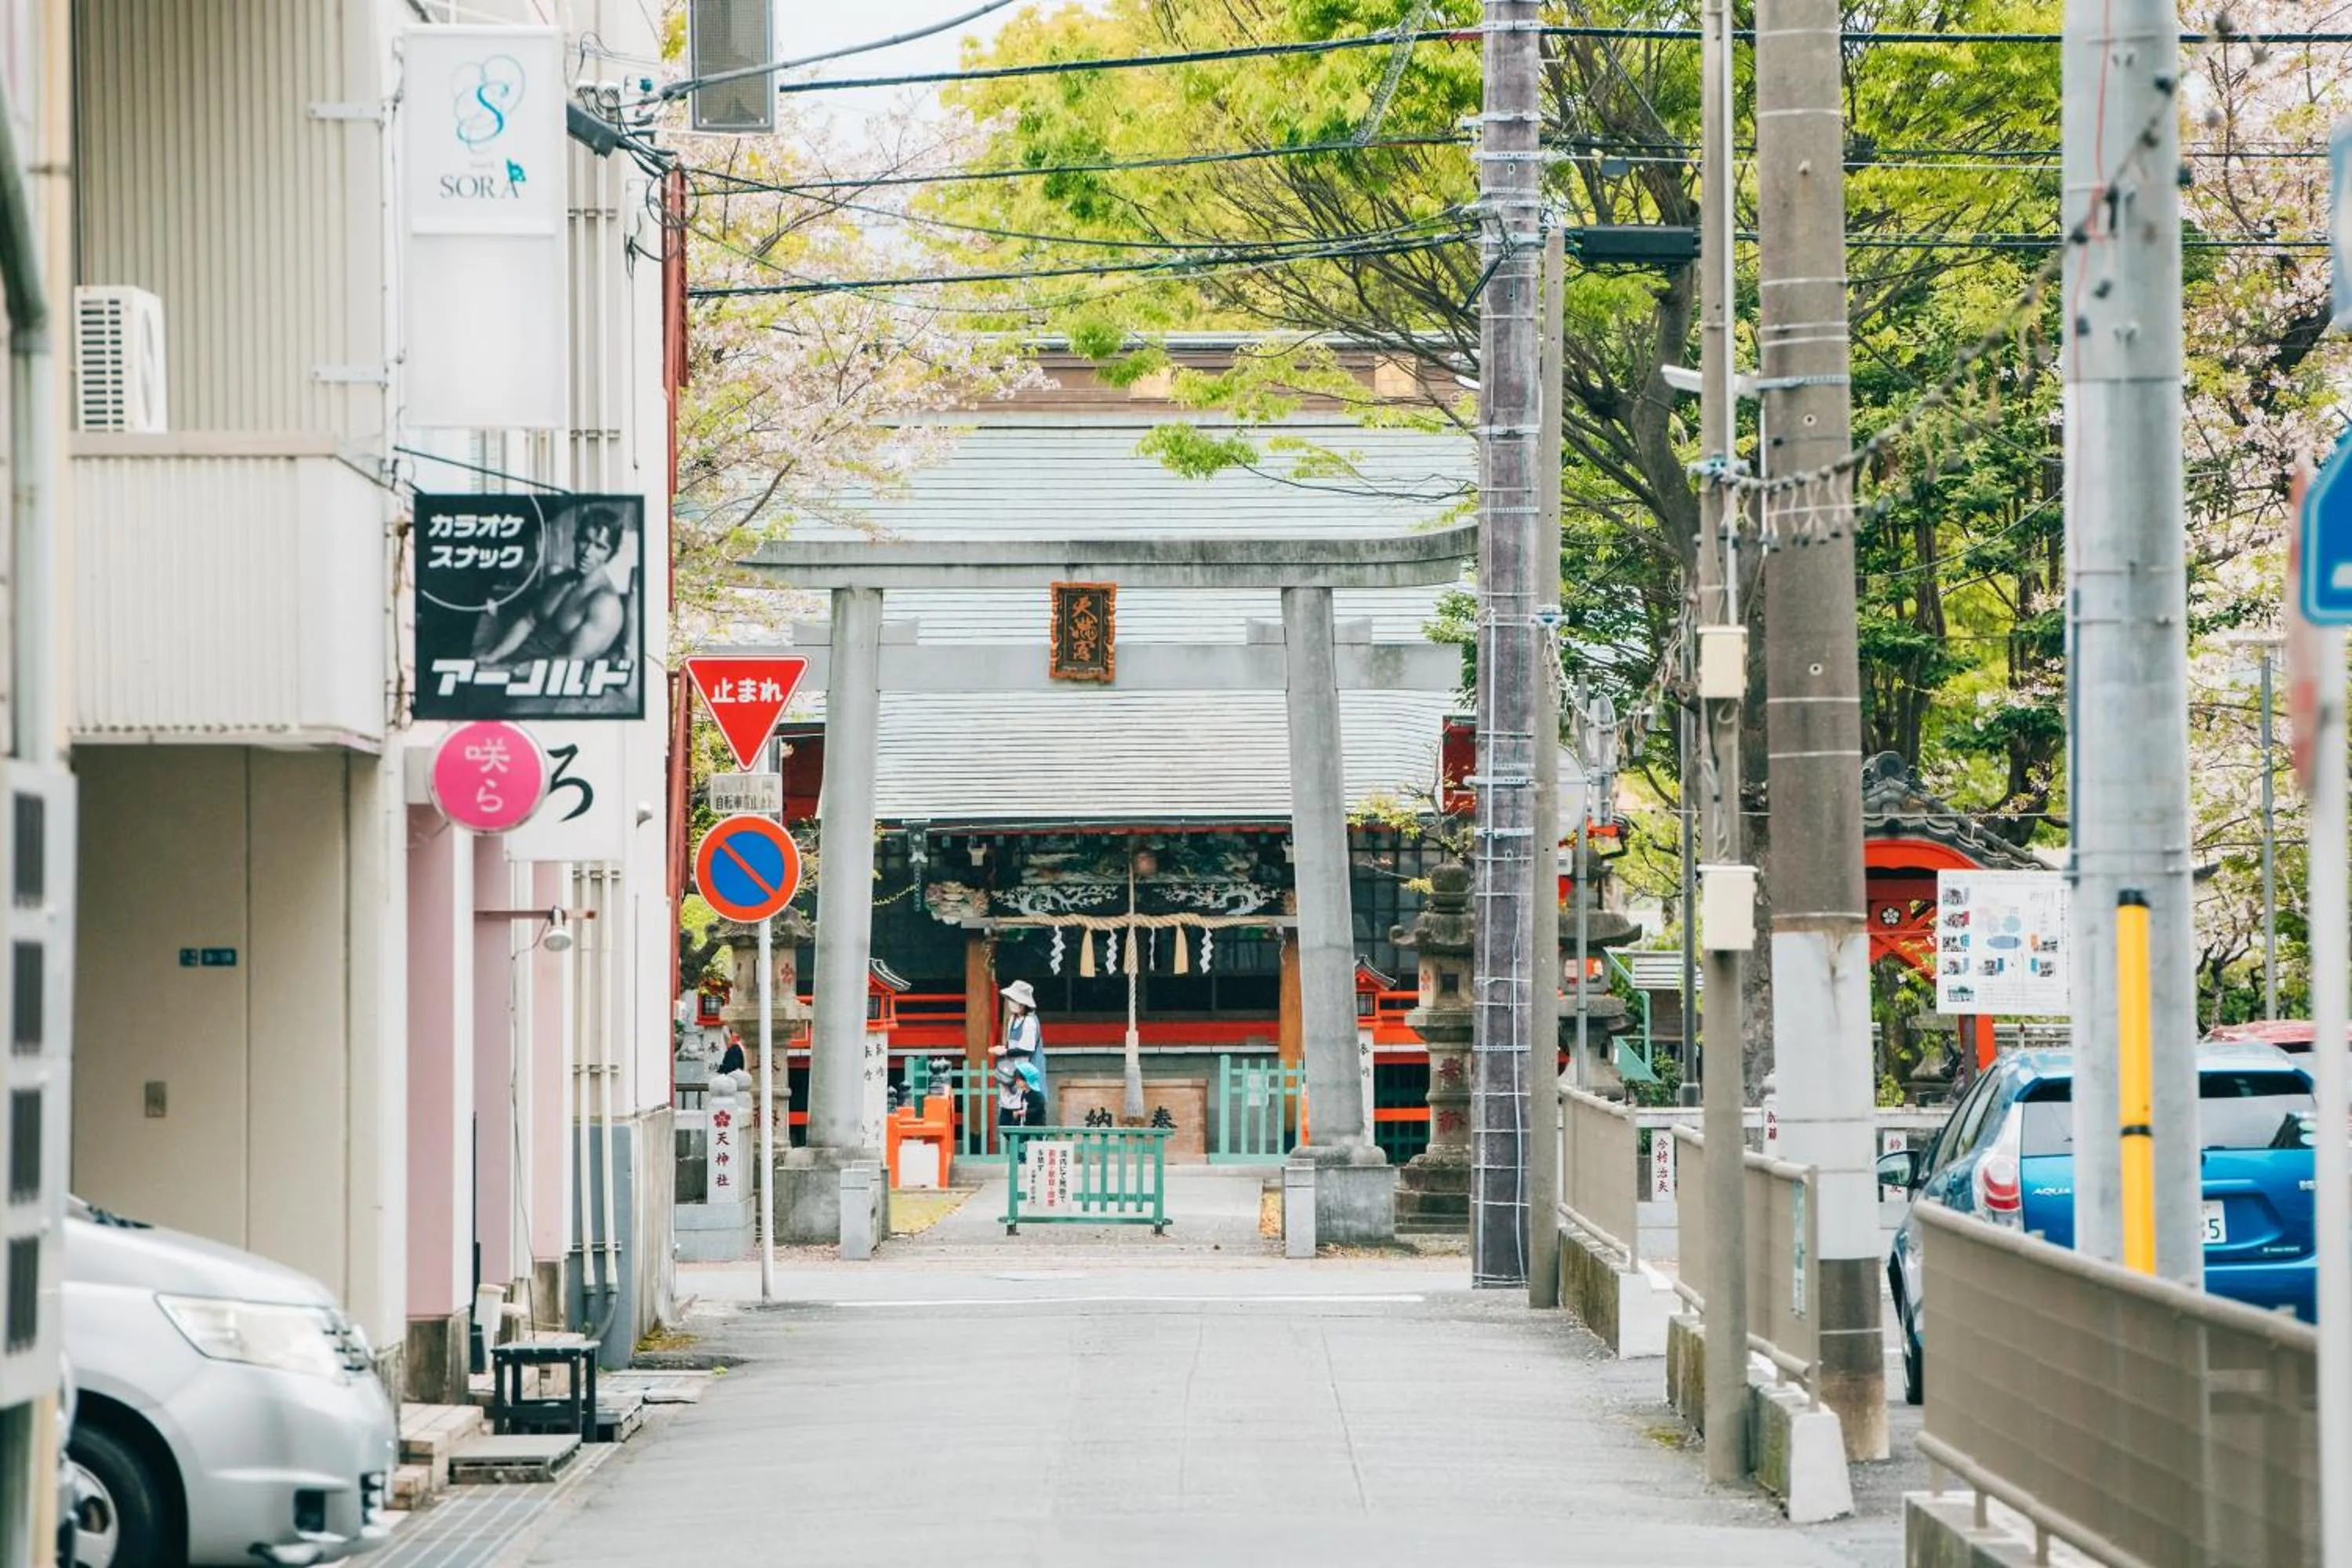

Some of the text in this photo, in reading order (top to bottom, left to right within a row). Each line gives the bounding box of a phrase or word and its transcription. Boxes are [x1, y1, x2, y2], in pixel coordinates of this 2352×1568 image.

[439, 163, 524, 198] SORA
[428, 514, 524, 539] カラオケ
[428, 546, 524, 568] スナック
[432, 659, 633, 696] アーノルド
[711, 677, 783, 703] 止まれ
[465, 737, 512, 813] 咲ら
[546, 743, 593, 822] ろ
[716, 1132, 731, 1187] 天神社
[2032, 1188, 2071, 1196] AQUA
